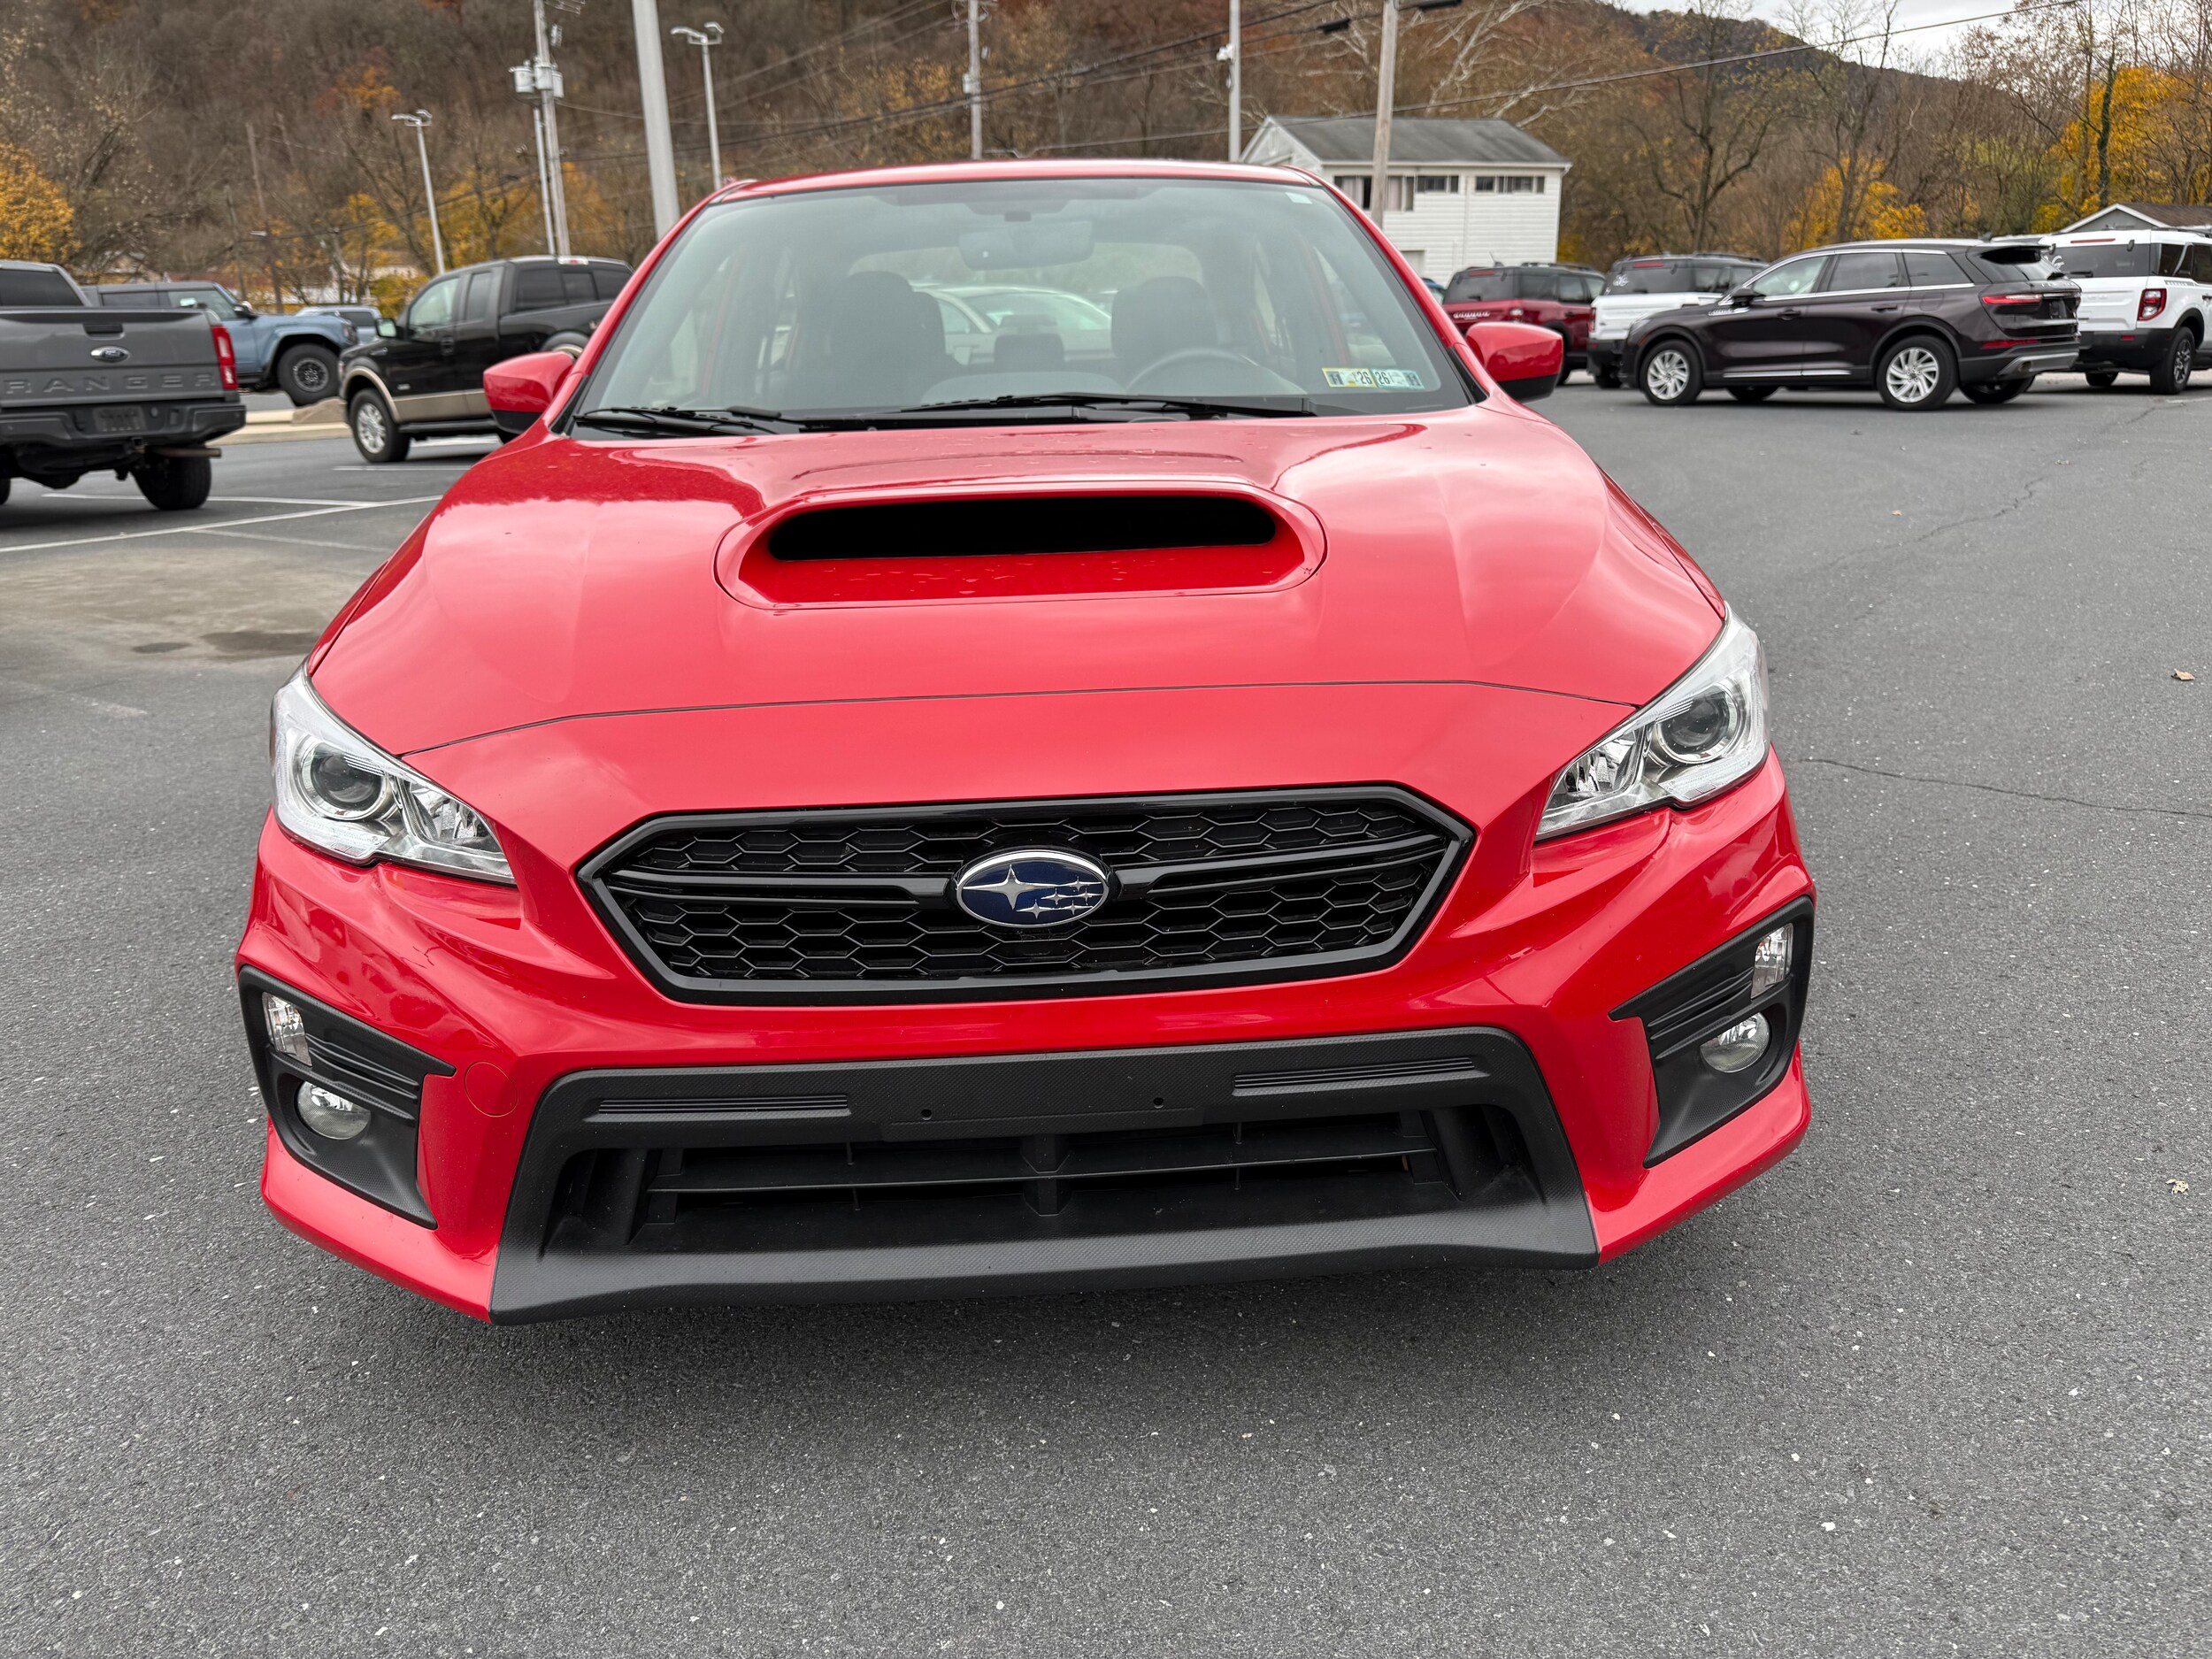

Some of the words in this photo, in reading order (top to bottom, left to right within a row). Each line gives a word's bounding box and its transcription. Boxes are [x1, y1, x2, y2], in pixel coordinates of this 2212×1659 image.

[5, 373, 217, 394] RANGER
[1356, 371, 1372, 385] 26
[1374, 371, 1391, 385] 26
